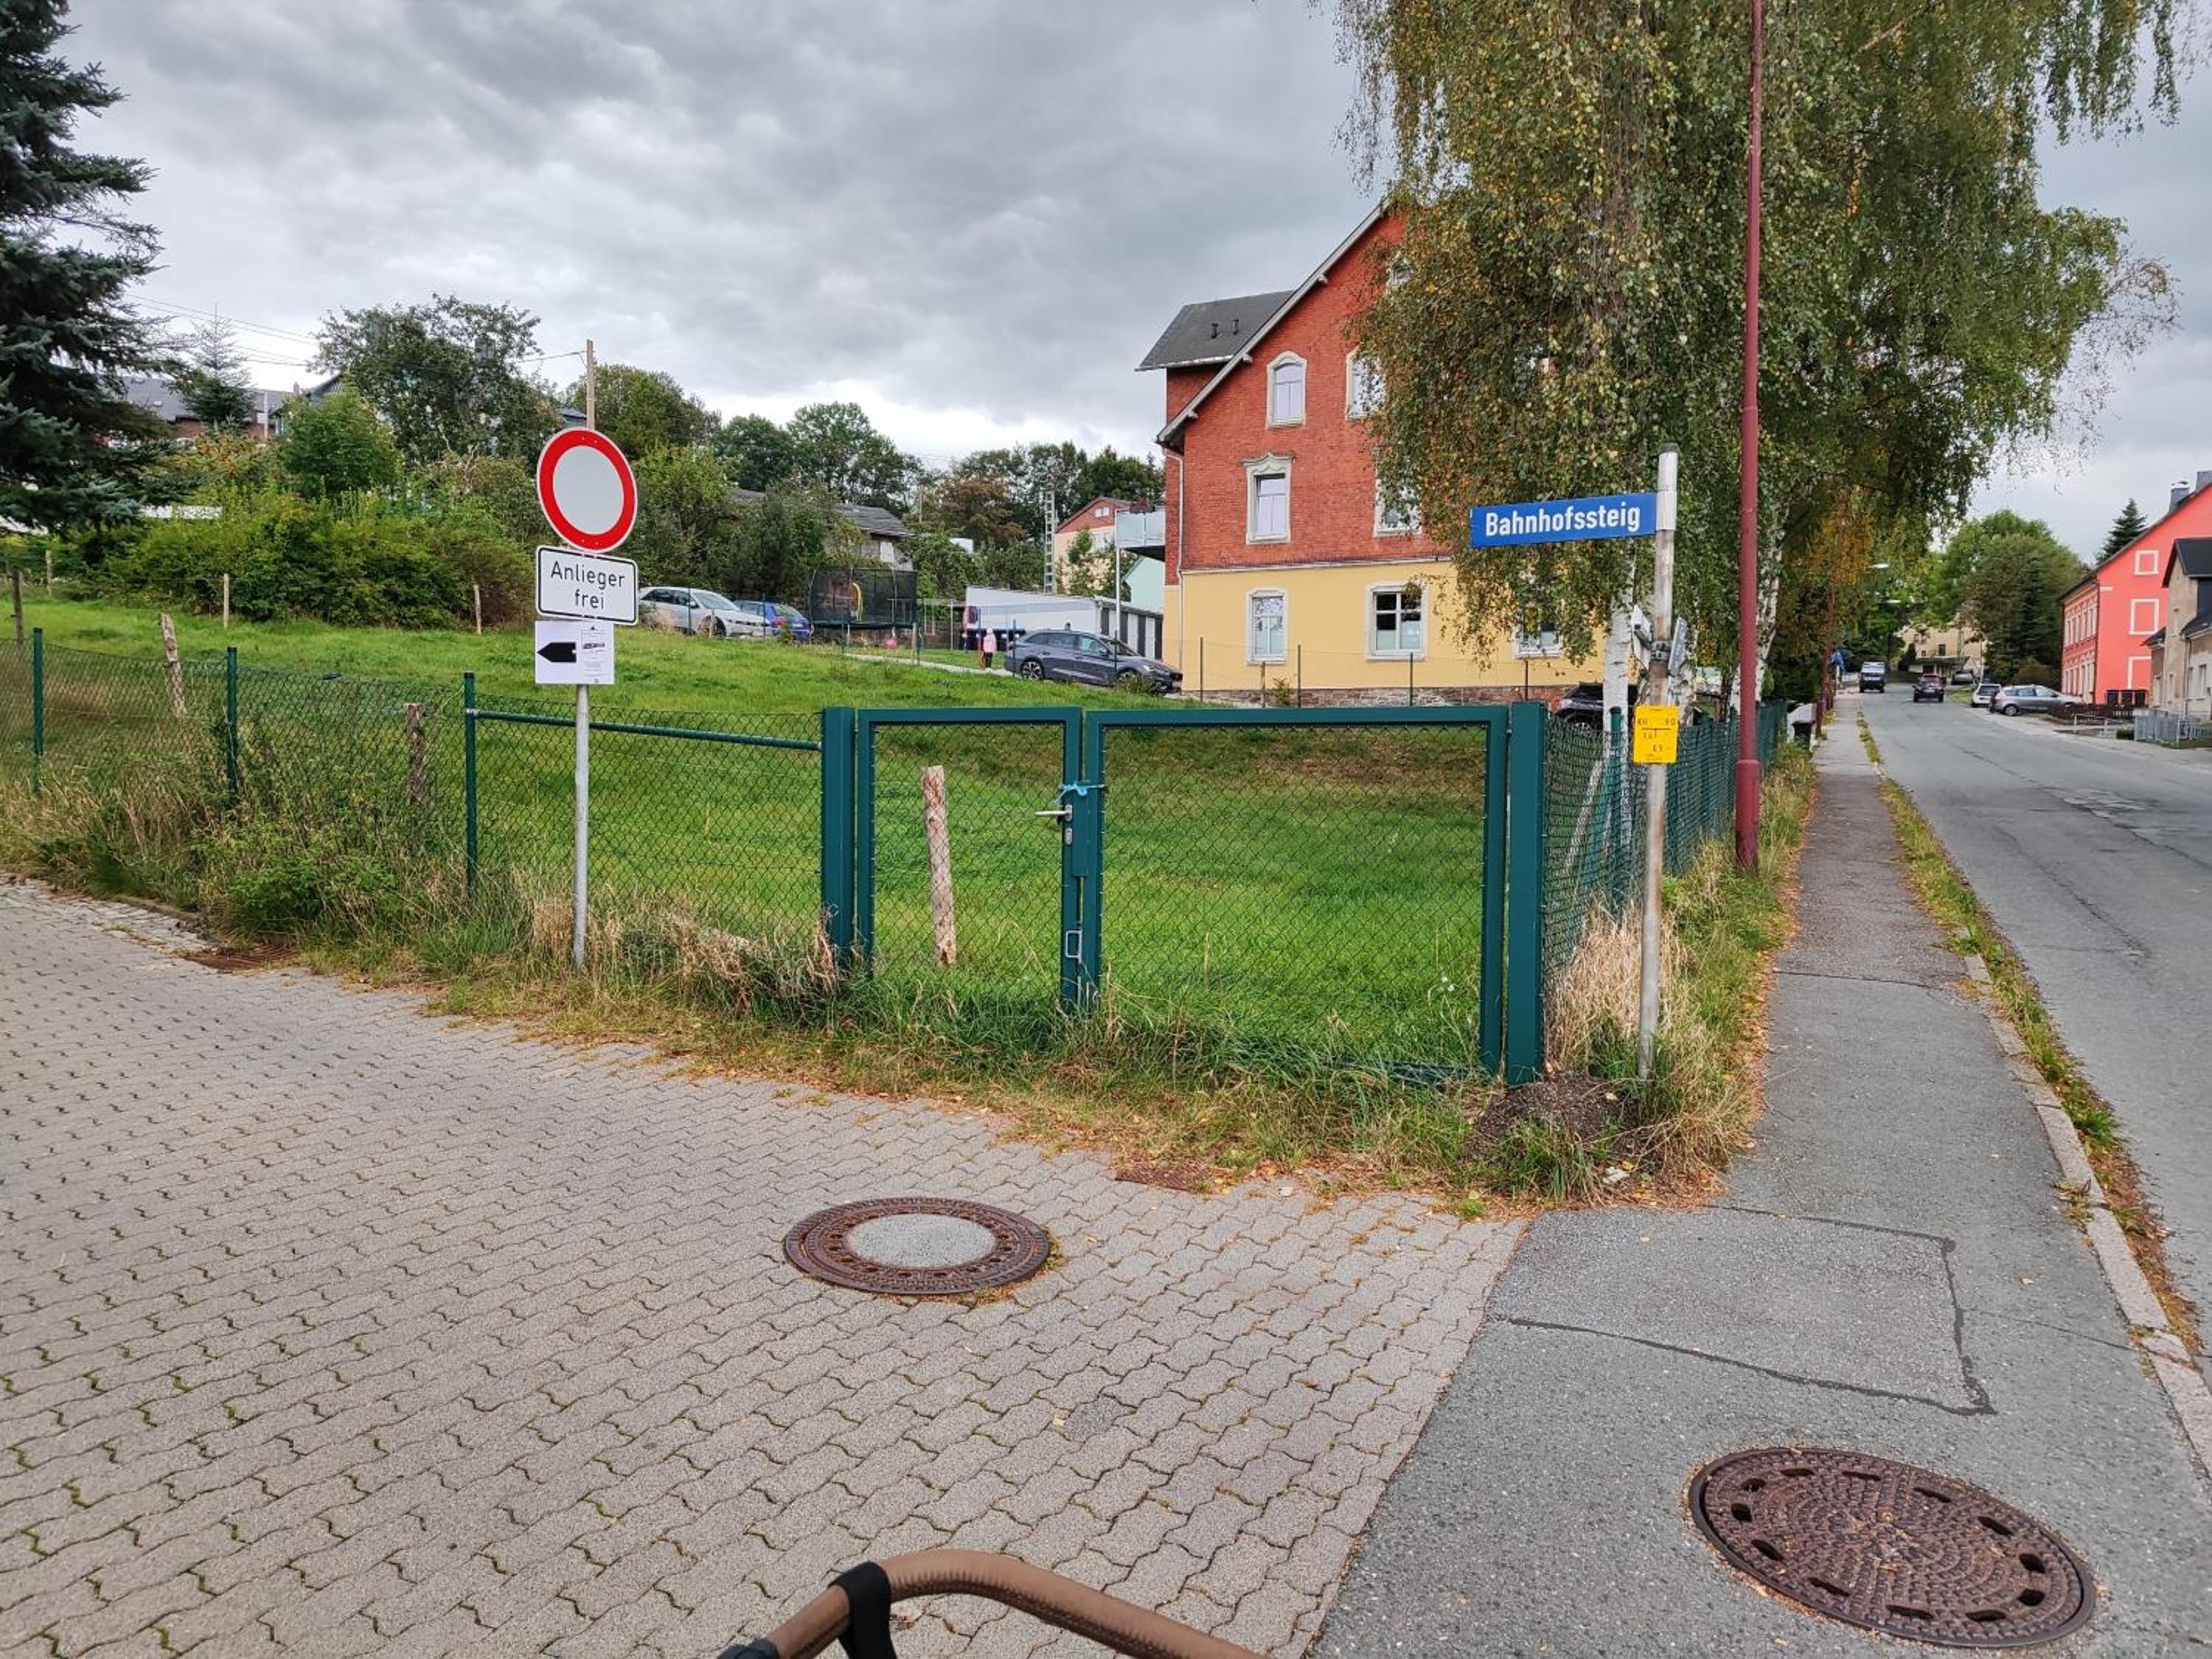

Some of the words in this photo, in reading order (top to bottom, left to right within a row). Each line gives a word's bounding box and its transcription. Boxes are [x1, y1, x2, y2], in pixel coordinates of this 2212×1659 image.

[1485, 502, 1641, 536] Bahnhofssteig
[551, 560, 625, 590] Anlieger
[574, 589, 605, 610] frei
